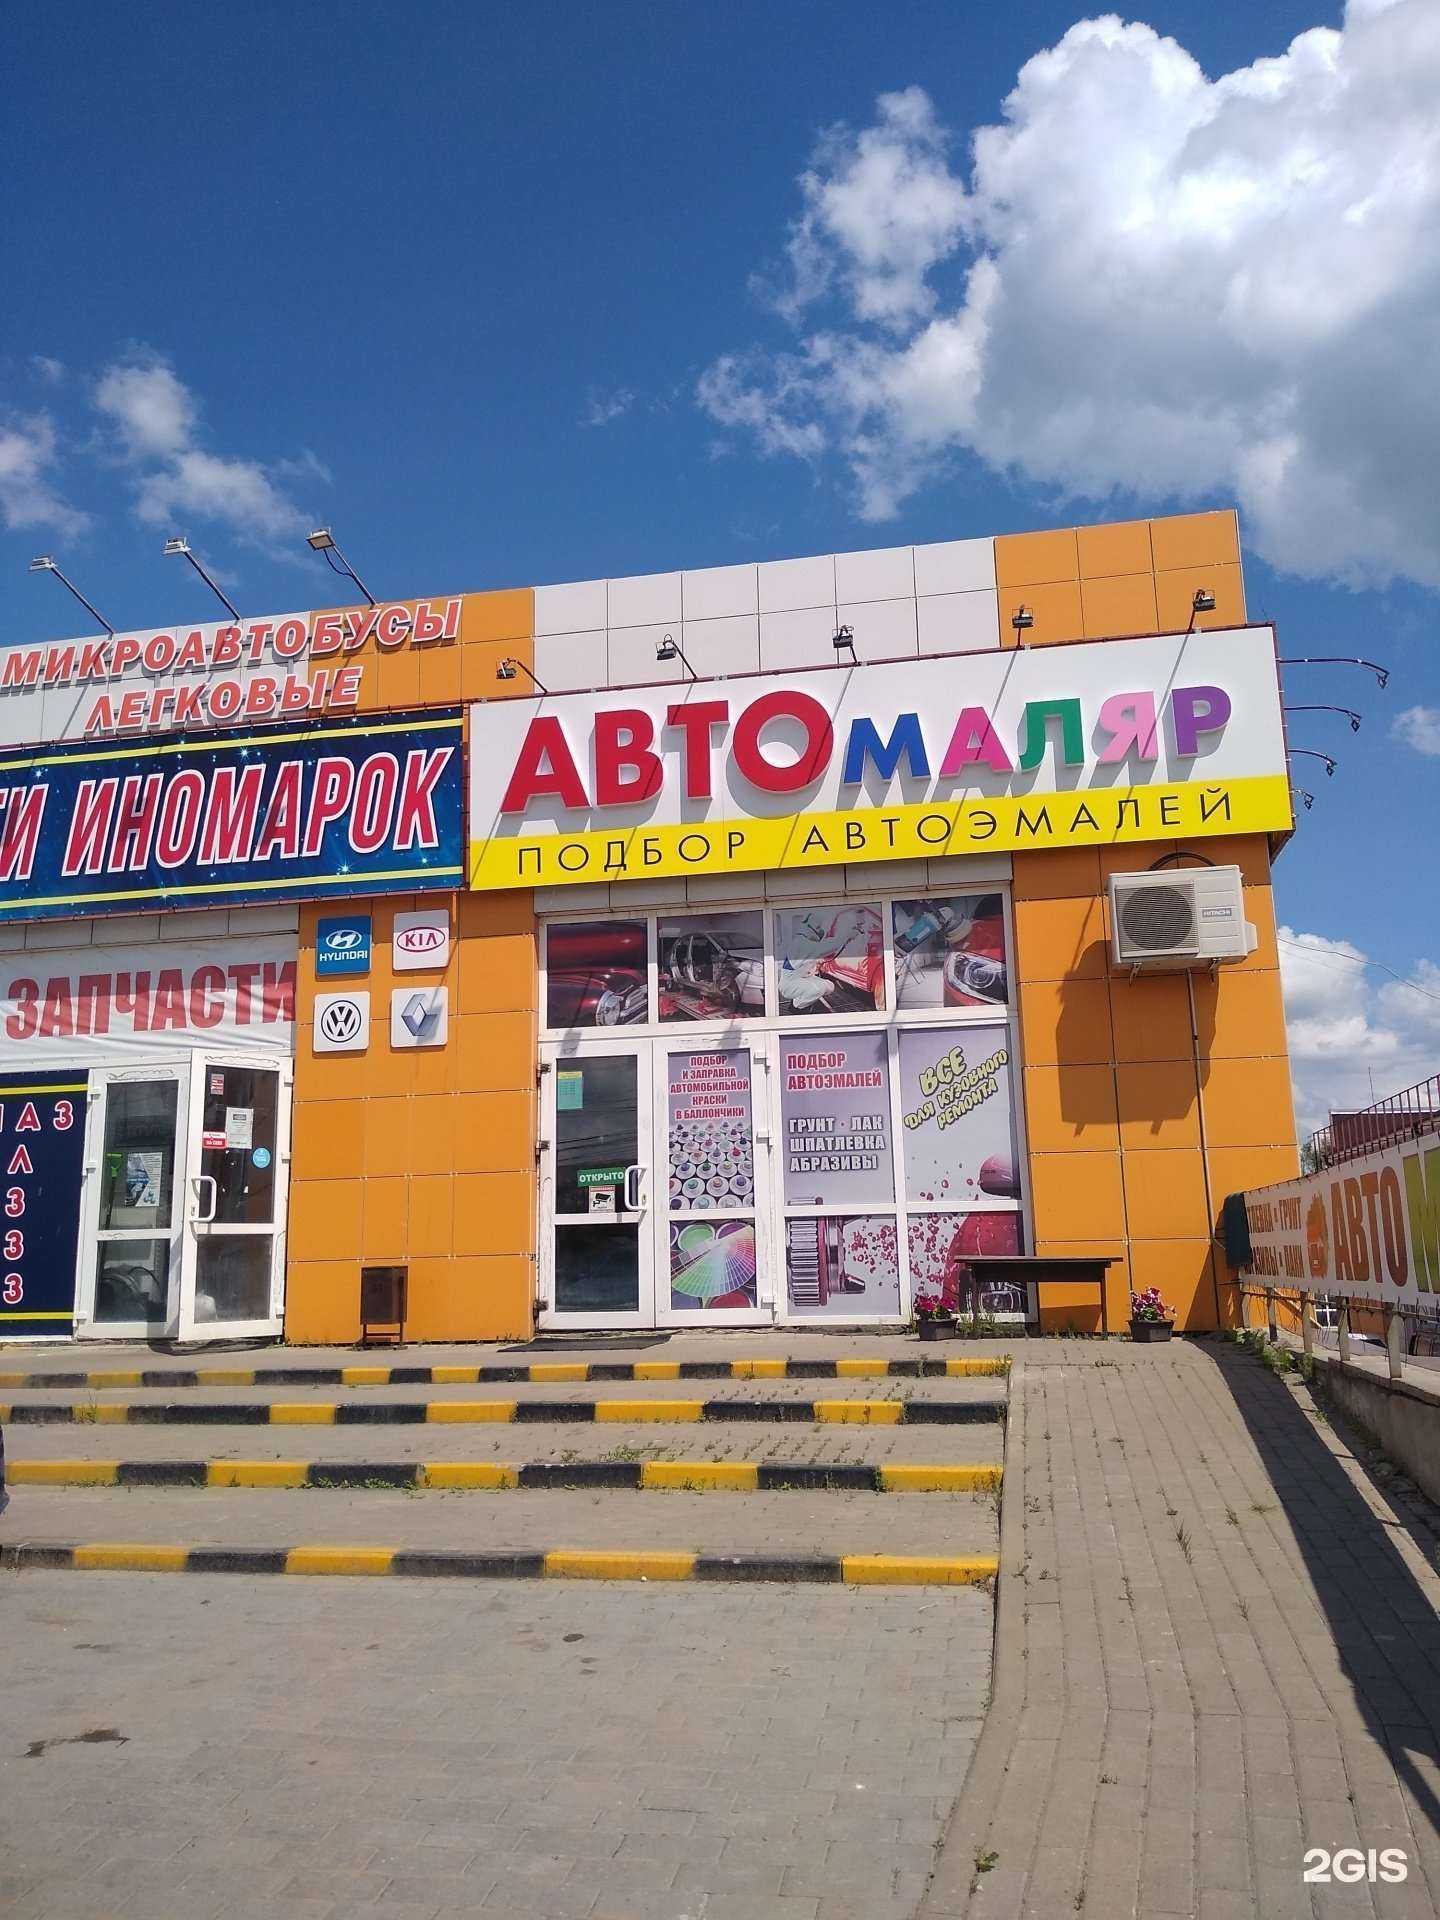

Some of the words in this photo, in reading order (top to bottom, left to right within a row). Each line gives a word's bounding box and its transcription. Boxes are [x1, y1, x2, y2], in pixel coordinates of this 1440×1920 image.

[2, 599, 462, 688] МИКРОАВТОБУСЫ
[85, 666, 362, 732] ЛЕГКОВЫЕ
[0, 784, 49, 881] И
[61, 746, 455, 877] ИНОМАРОК
[517, 831, 746, 875] ПОДБОР
[802, 788, 1236, 855] АВТОЭМАЛЕЙ
[405, 933, 438, 947] KIA
[319, 950, 368, 962] HYUNDAI
[5, 960, 297, 1040] ЗАПЧАСТИ
[690, 1055, 728, 1067] ПОДБОР
[787, 1053, 846, 1070] ПОДБОР
[682, 1070, 689, 1080] И
[690, 1068, 736, 1080] ЗАПРАВКА
[787, 1069, 882, 1090] АВТОЭМАЛЕЙ
[919, 1045, 967, 1097] ВСЕ
[670, 1079, 749, 1094] АВТОМОБИЛЬНОЙ
[904, 1101, 936, 1129] ДЛЯ
[937, 1049, 1009, 1109] КУЗОВНОГО
[692, 1094, 728, 1106] КРАСКИ
[937, 1078, 998, 1131] РЕМОНТА
[676, 1110, 682, 1120] В
[684, 1107, 745, 1119] БАЛЛОНЧИКИ
[789, 1117, 836, 1133] ГРУНТ
[850, 1115, 884, 1131] ЛАК
[789, 1135, 886, 1152] ШПАТЛЕВКА
[790, 1154, 879, 1172] АБРАЗИВЫ
[579, 1171, 625, 1183] ОТКРЫТО
